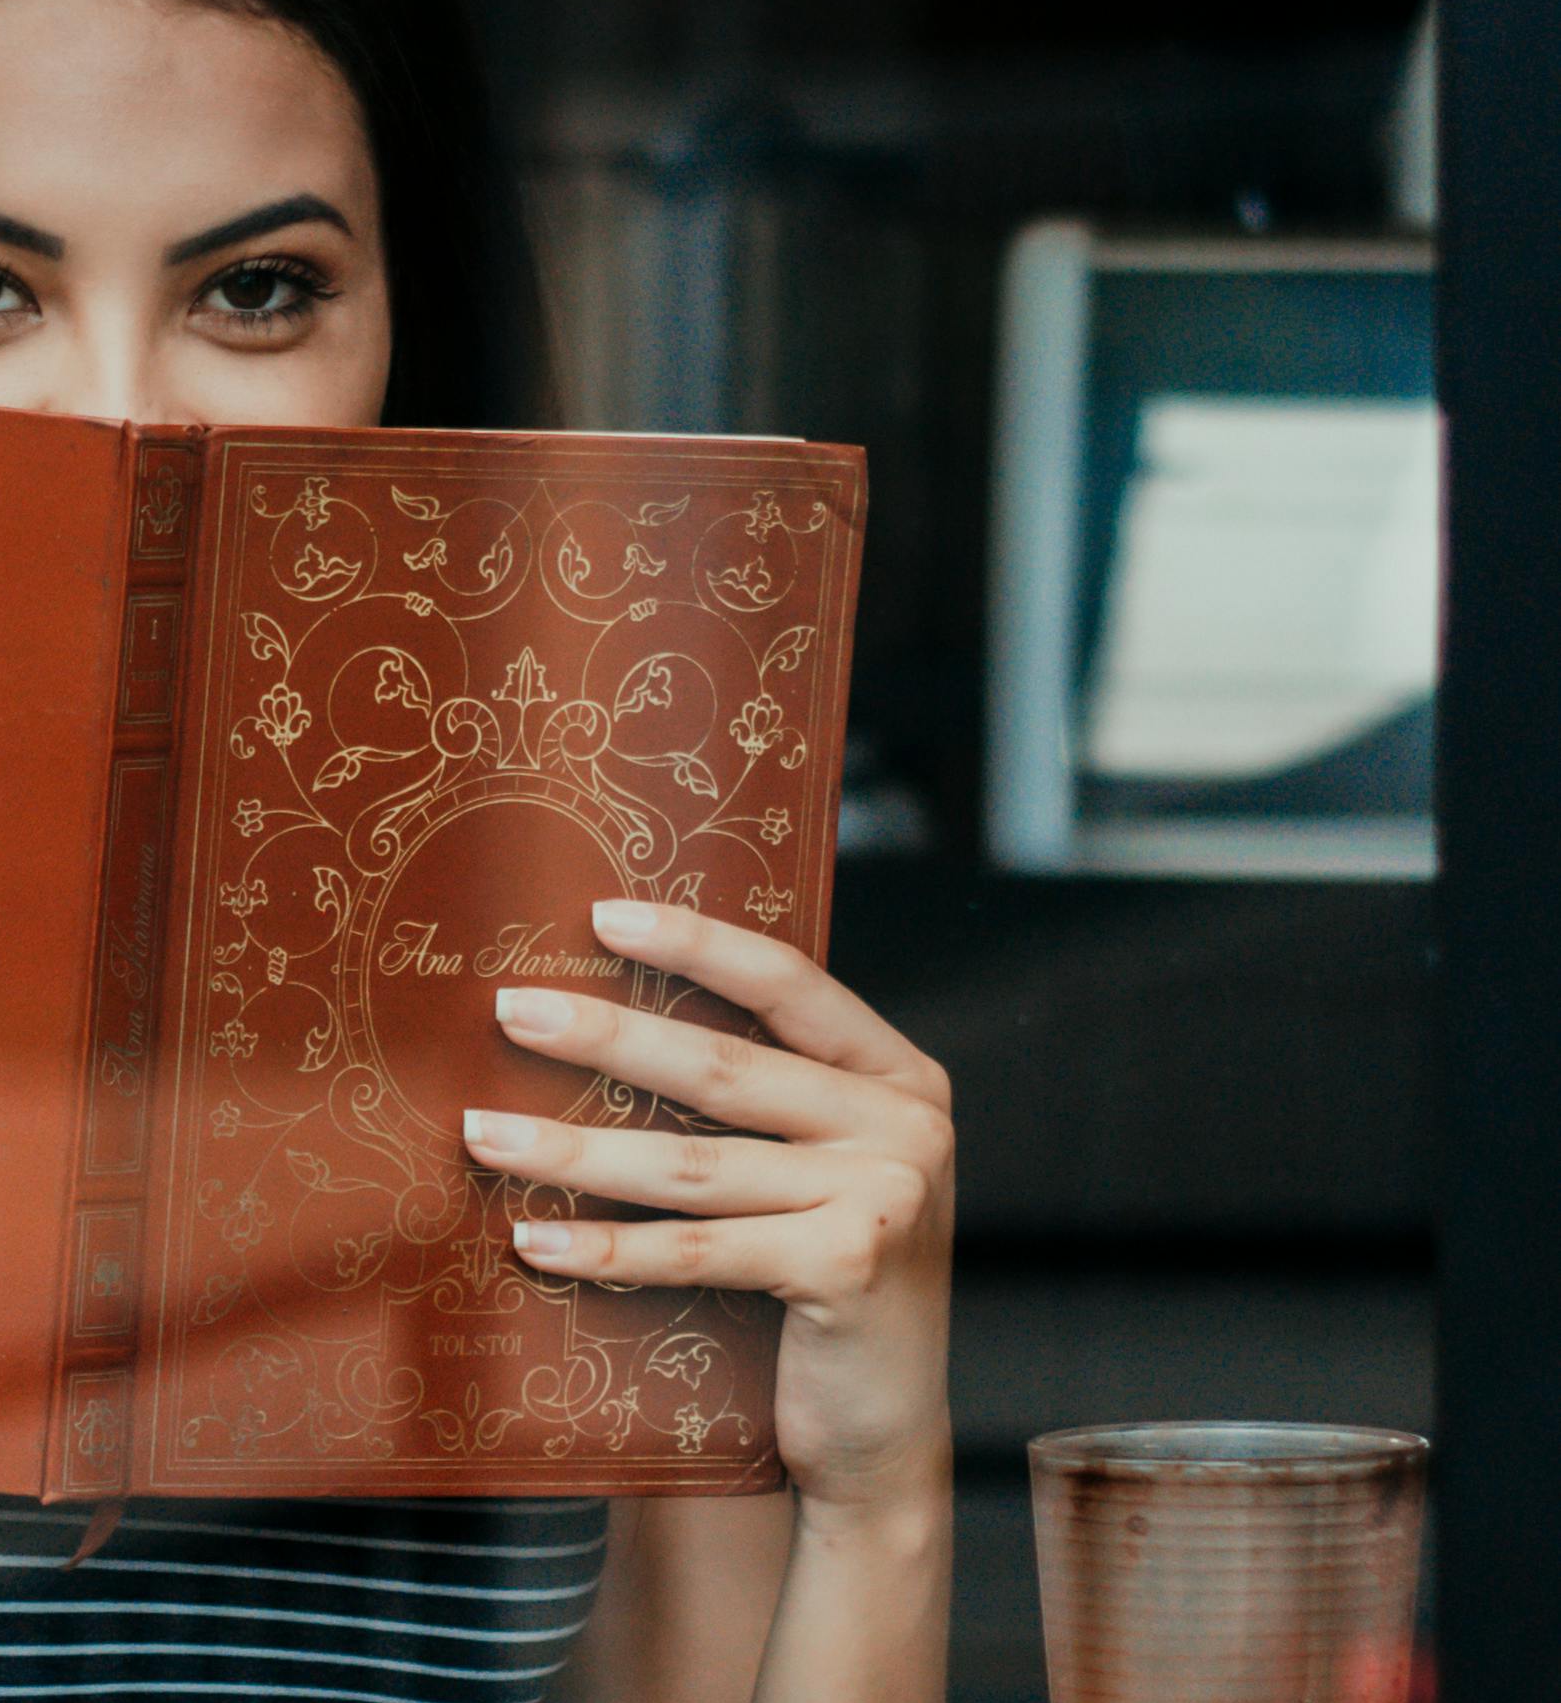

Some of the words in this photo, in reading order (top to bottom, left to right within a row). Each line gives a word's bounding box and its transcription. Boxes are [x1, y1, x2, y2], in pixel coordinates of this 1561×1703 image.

[379, 920, 463, 977] Ana
[473, 922, 624, 978] Karênina
[101, 1009, 144, 1097] Ana
[430, 1330, 523, 1356] TOLSTÓI
